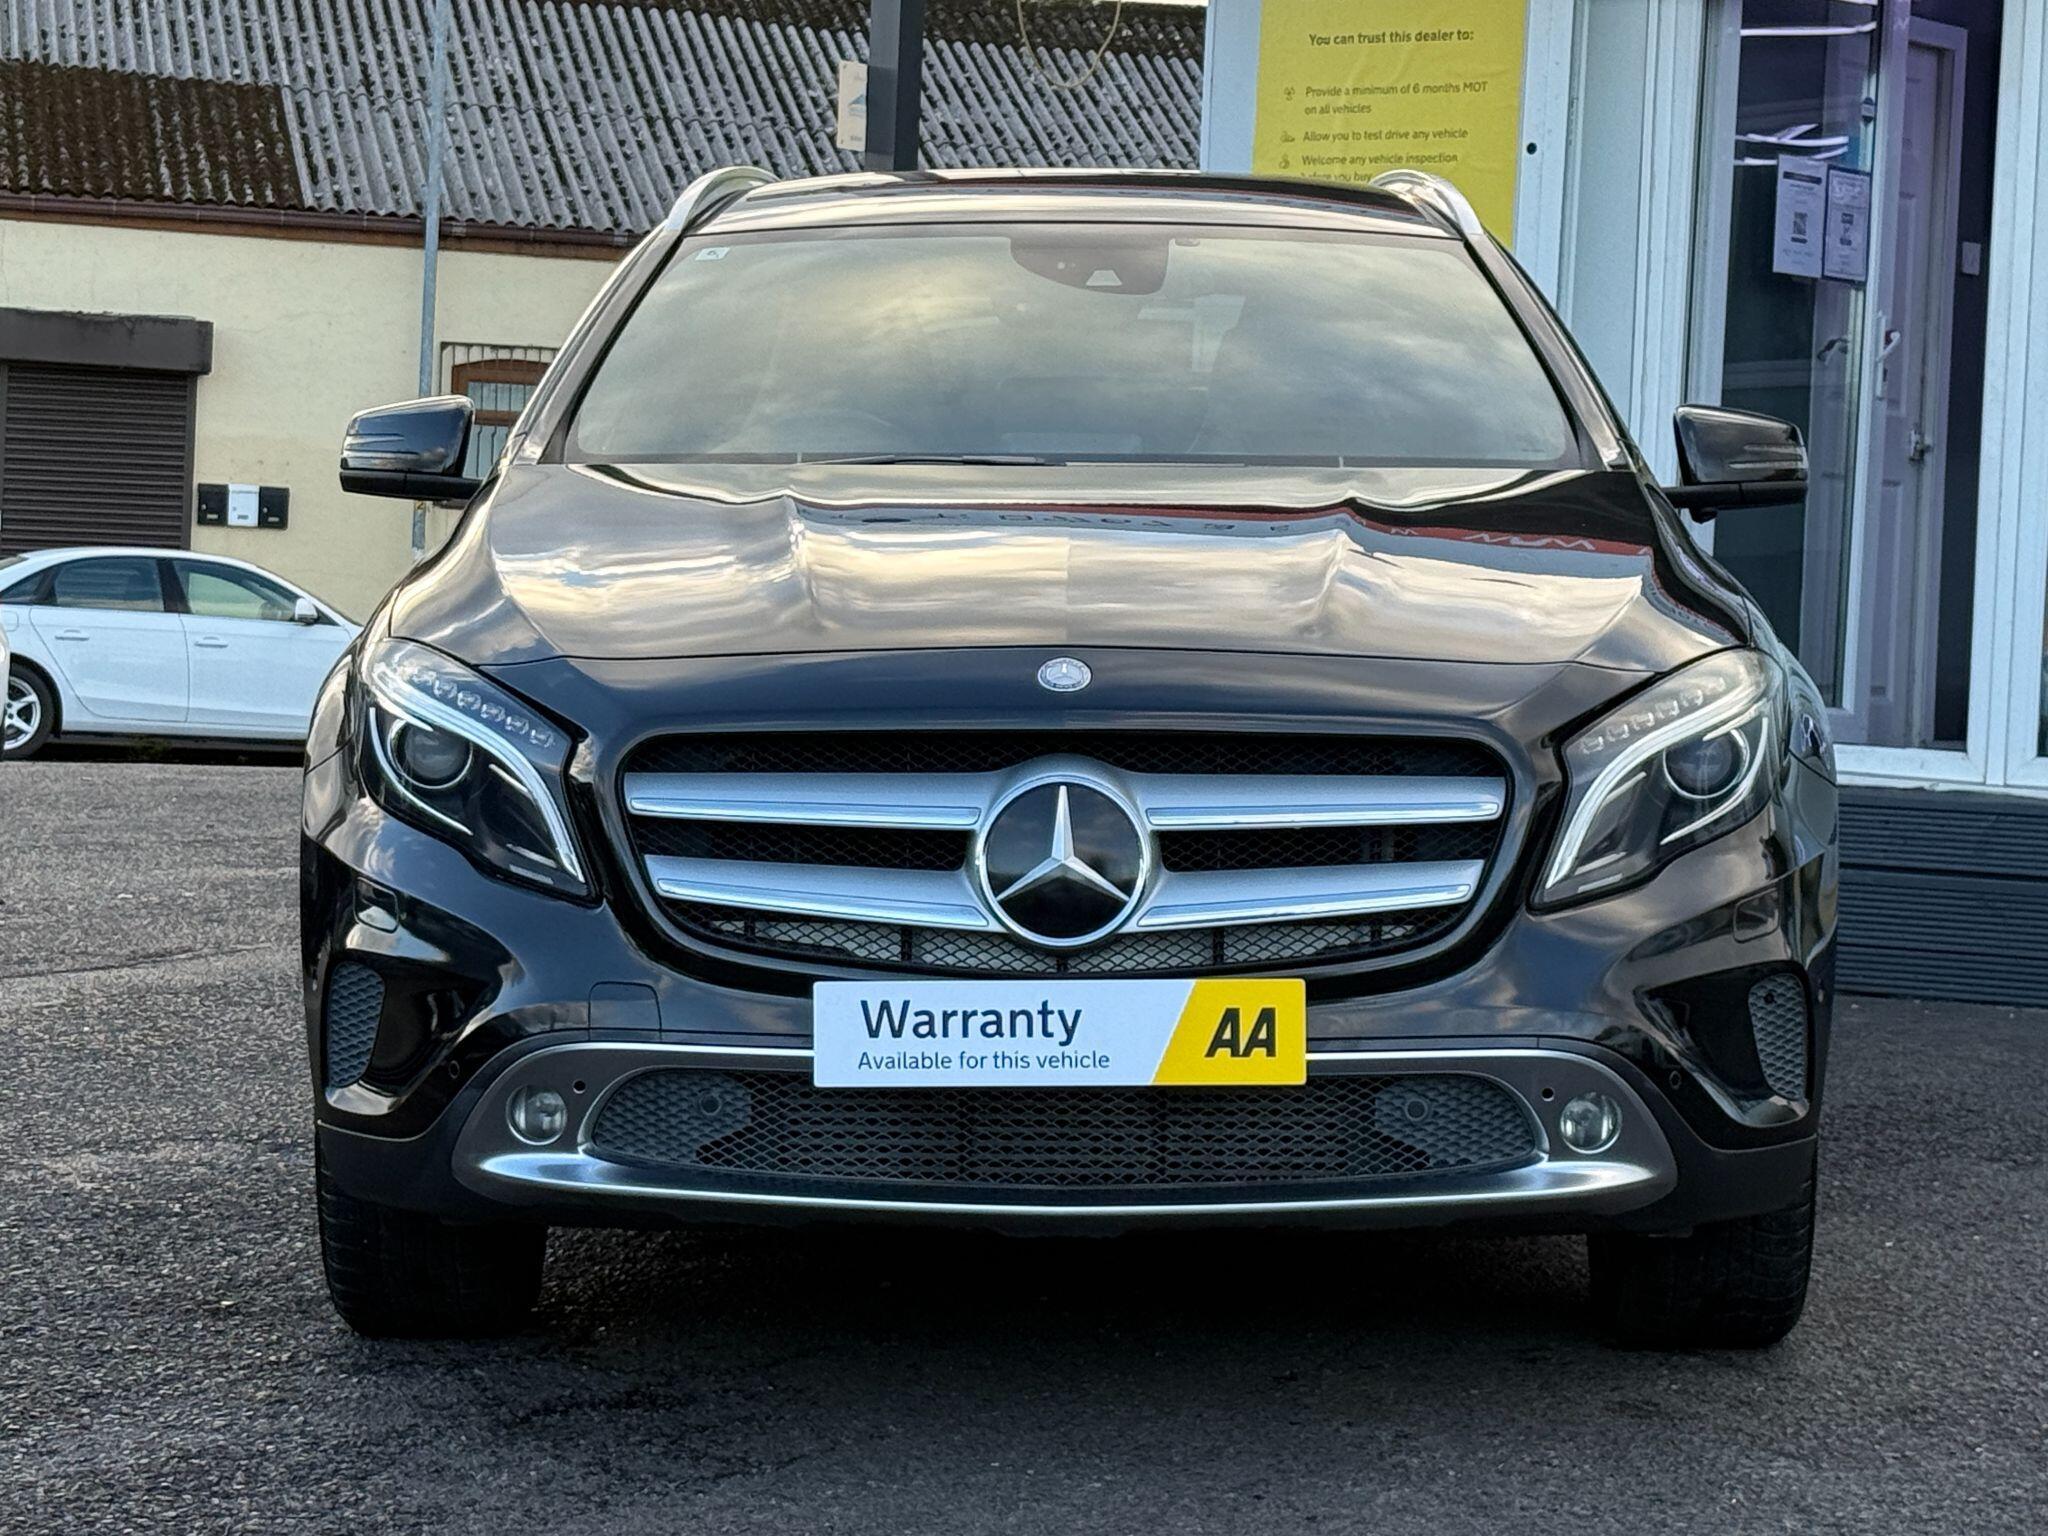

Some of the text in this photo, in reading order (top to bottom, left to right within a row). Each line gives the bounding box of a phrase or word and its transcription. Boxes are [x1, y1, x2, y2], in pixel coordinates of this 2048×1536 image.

[1309, 29, 1474, 46] You can trust this dealer to:
[1305, 81, 1488, 97] Provide a minimum of 6 months MOT
[1305, 103, 1372, 115] on all vehicles
[1303, 128, 1468, 143] Allow you to test drive any vehicle
[1302, 153, 1458, 167] Welcome any vehicle inspection
[1354, 171, 1373, 184] buy
[860, 999, 1083, 1047] Warranty
[1204, 1007, 1277, 1059] AA
[858, 1050, 1111, 1070] Available for this vehicle
